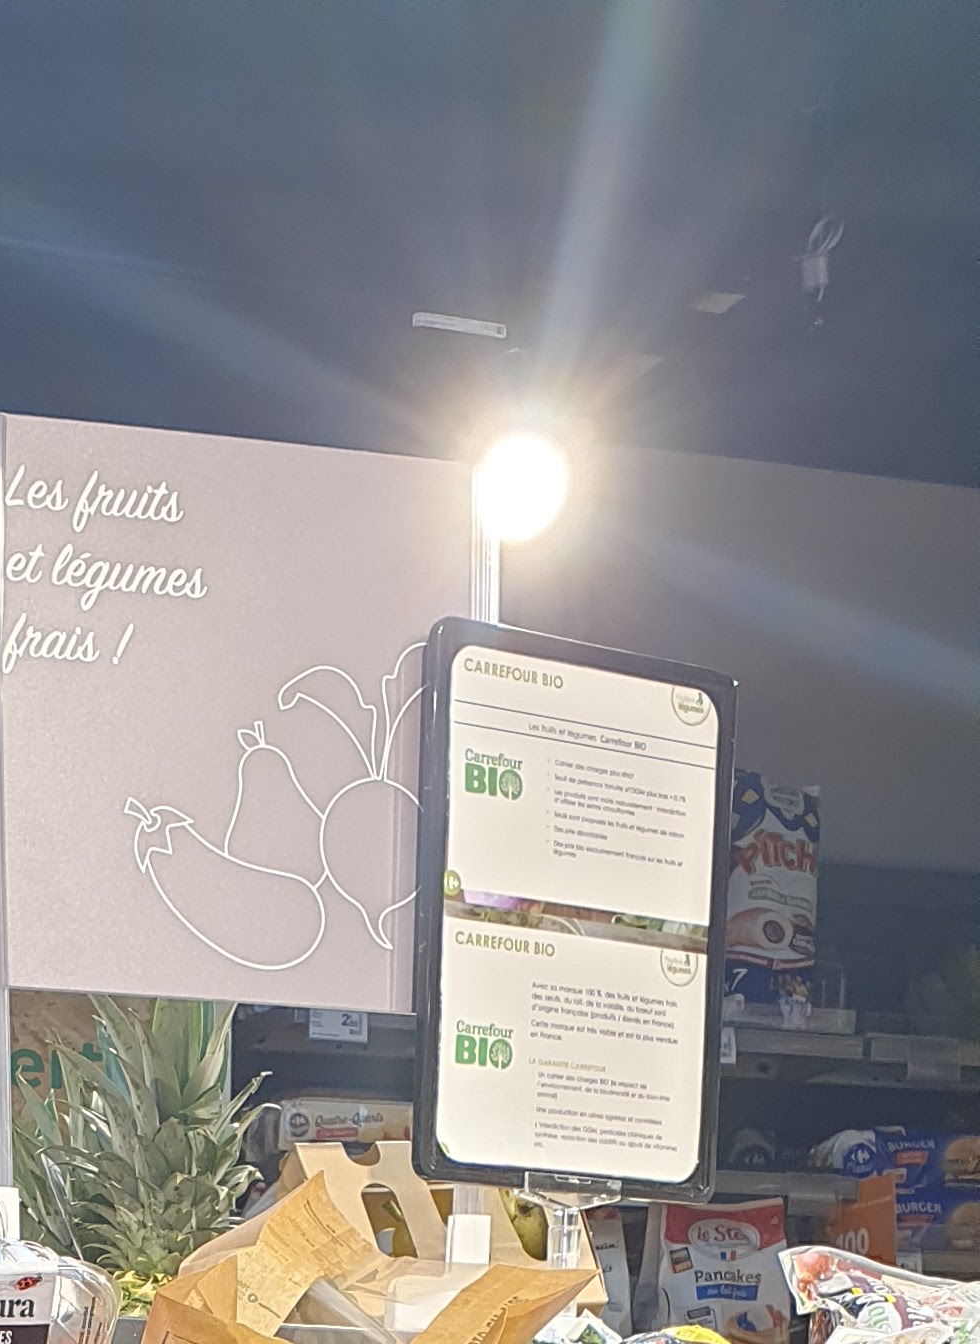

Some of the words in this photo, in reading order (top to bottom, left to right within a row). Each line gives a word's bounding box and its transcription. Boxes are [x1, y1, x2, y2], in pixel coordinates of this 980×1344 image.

[4, 464, 68, 512] Les
[72, 471, 184, 533] fruits
[6, 544, 42, 584] et
[51, 544, 207, 611] légumes
[3, 613, 99, 674] frais
[112, 623, 133, 665] !
[464, 658, 538, 684] CARREFOUR
[542, 673, 563, 688] BIO
[528, 722, 540, 731] Les
[465, 748, 523, 770] Carrefour
[465, 763, 523, 800] BIO
[456, 931, 530, 954] CARREFOUR
[534, 943, 555, 956] BIO
[456, 1020, 513, 1039] Carrefour
[455, 1034, 513, 1070] BIO
[695, 1269, 761, 1284] Pancakes
